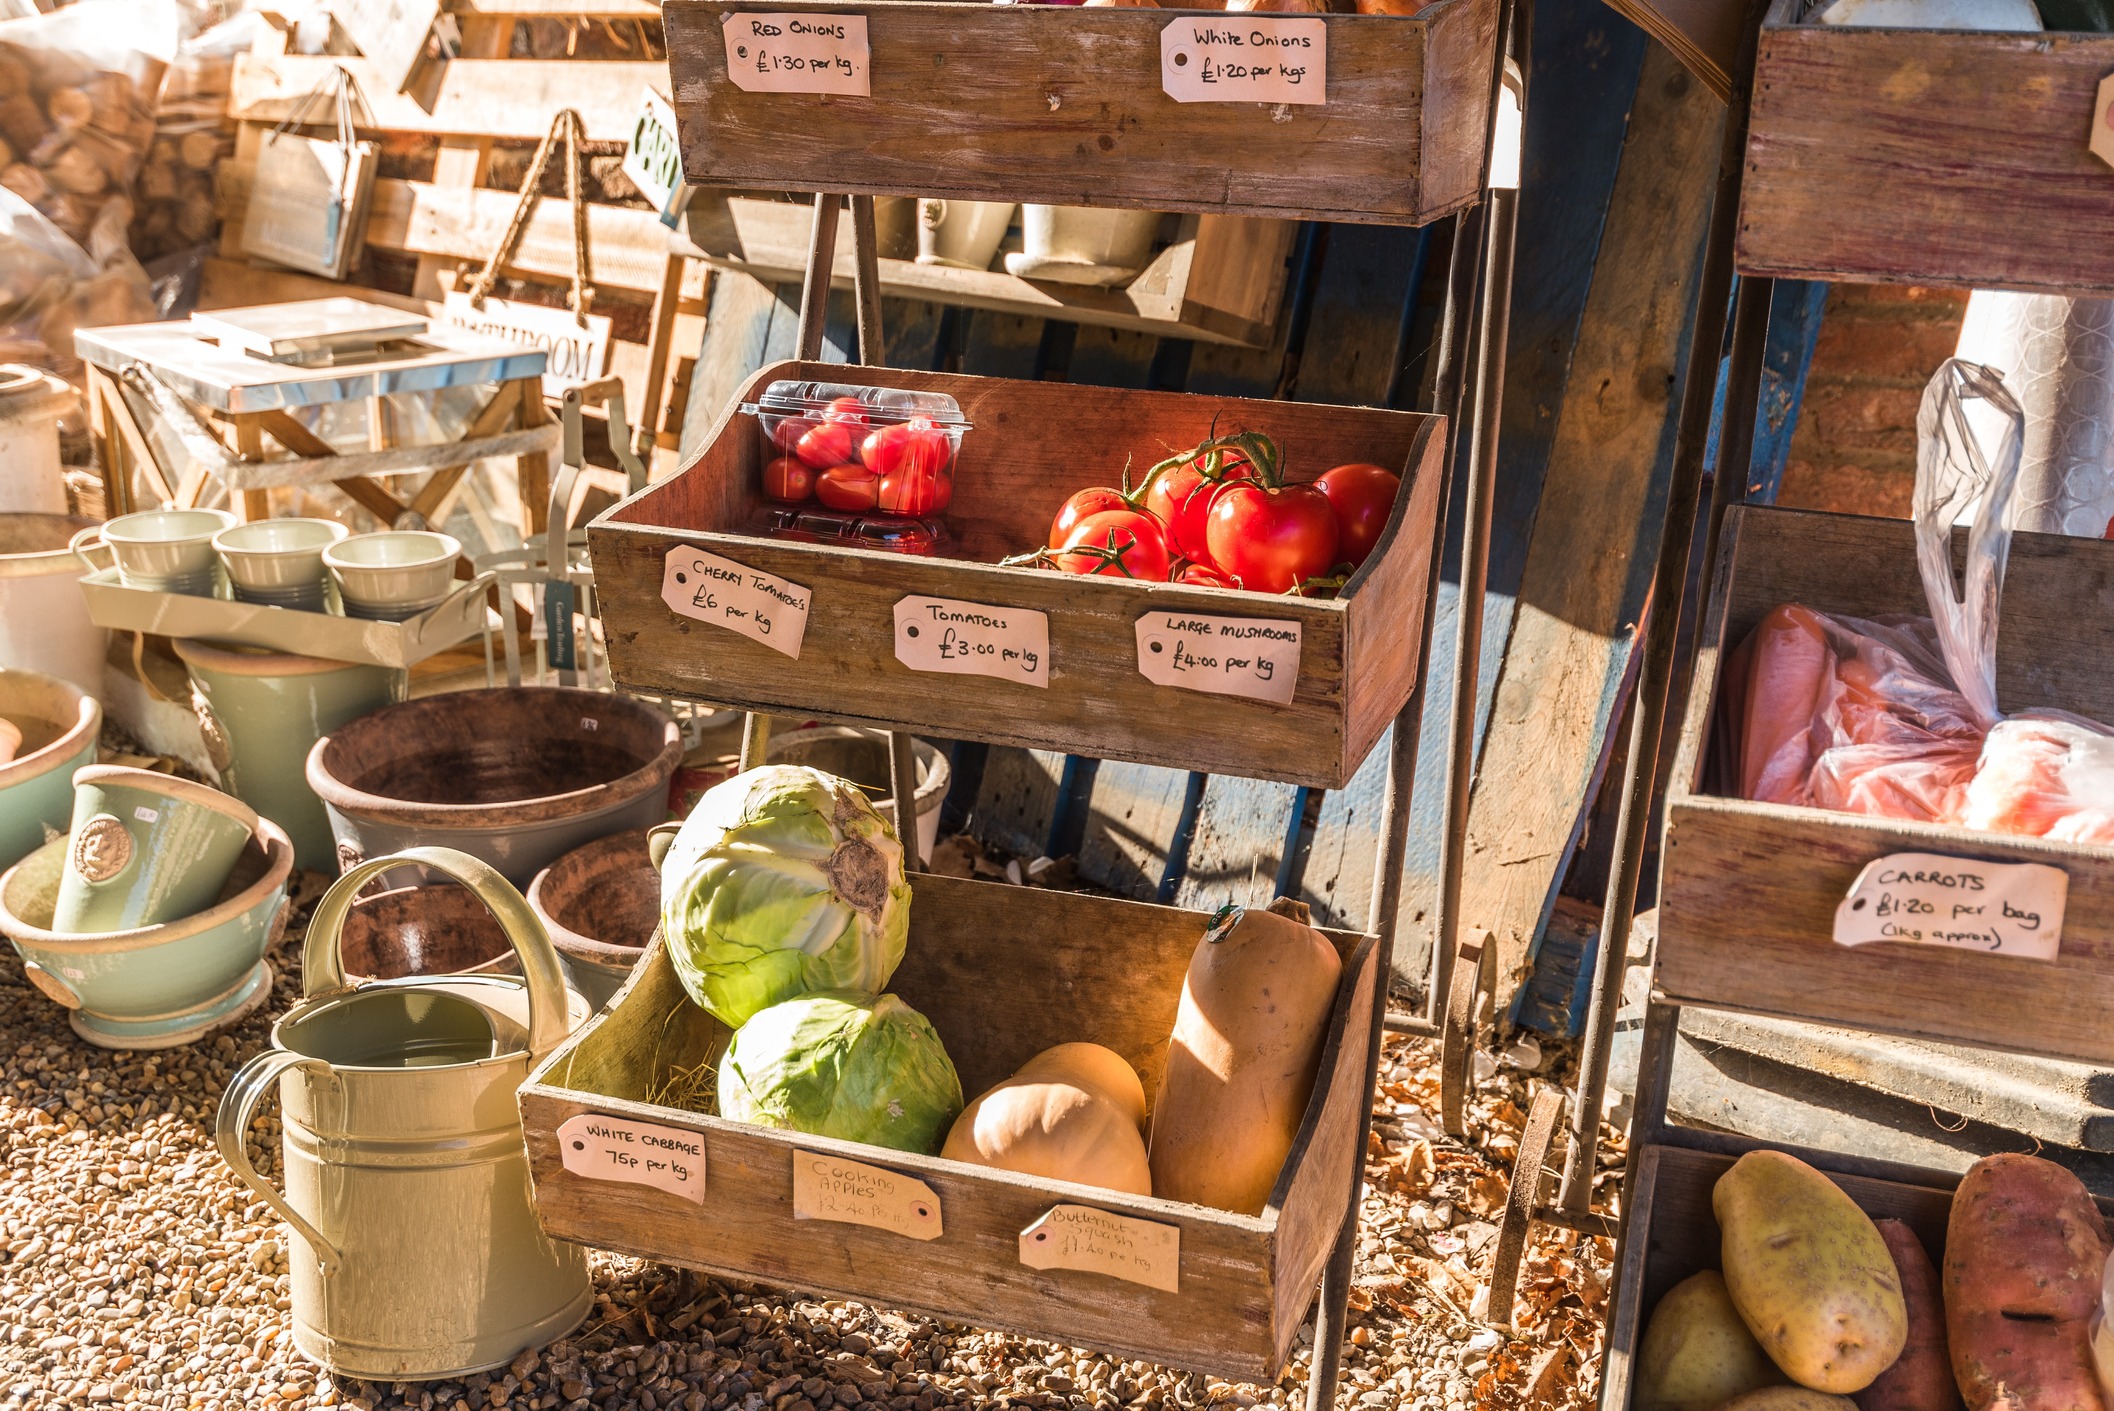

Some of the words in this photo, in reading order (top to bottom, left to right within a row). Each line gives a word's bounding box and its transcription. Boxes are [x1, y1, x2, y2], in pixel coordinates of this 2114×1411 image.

[750, 20, 783, 37] RED
[789, 20, 845, 39] ONIONS
[1193, 28, 1245, 46] White
[1250, 30, 1311, 48] Onions
[756, 50, 805, 73] £1.30
[809, 58, 831, 73] per
[1201, 57, 1247, 83] £1.20
[1250, 66, 1273, 81] per
[1279, 63, 1306, 84] kgs
[692, 560, 742, 587] CHERRY
[692, 584, 718, 609] £6
[726, 604, 749, 618] per
[755, 609, 771, 634] kg
[926, 605, 1007, 629] TOMATOES
[1166, 617, 1212, 635] LARGE
[1220, 625, 1297, 643] MUSHROOMS
[938, 627, 995, 660] £3.00
[1002, 648, 1020, 661] per
[1021, 648, 1039, 673] kg
[1226, 657, 1251, 673] per
[1255, 656, 1274, 681] kg
[1878, 869, 1985, 891] CARROTS
[1952, 902, 1988, 920] per
[2002, 900, 2041, 930] bag
[1932, 926, 2001, 951] approx)
[586, 1125, 635, 1142] WHITE
[641, 1135, 701, 1156] CABBAGE
[605, 1150, 639, 1168] 75p
[646, 1159, 667, 1172] per
[672, 1160, 687, 1181] kg
[812, 1161, 895, 1194] Cooking
[1051, 1210, 1130, 1233] Butternut
[1069, 1223, 1133, 1248] Squash
